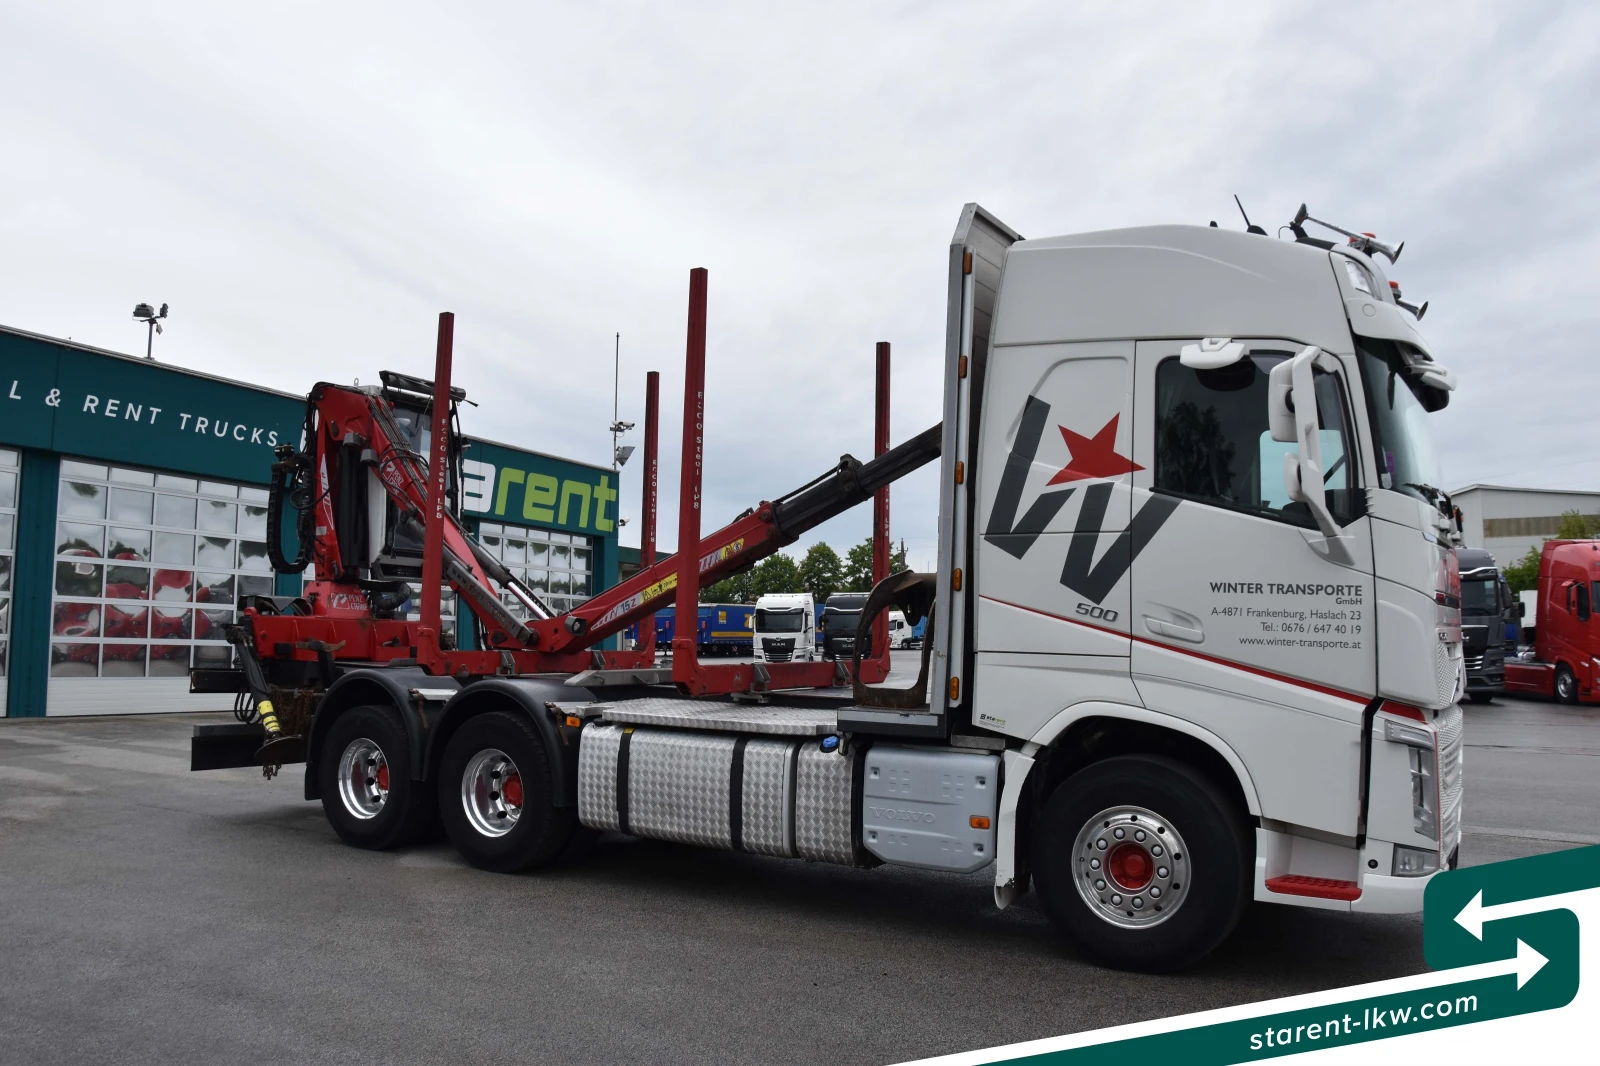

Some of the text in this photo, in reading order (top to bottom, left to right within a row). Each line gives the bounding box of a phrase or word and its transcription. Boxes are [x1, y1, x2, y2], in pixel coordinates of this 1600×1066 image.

[45, 388, 62, 407] &
[82, 394, 162, 425] RENT
[179, 412, 279, 447] TRUCKS
[1210, 582, 1363, 597] WINTER TRANSPORTE
[1335, 597, 1363, 606] GmbH
[1075, 602, 1119, 623] 500
[1210, 607, 1362, 621] A-4871 Frankenburg, Haslach 23
[1281, 623, 1305, 633] 0676
[1313, 624, 1332, 634] 647
[1334, 625, 1347, 634] 40
[1350, 625, 1362, 635] 19
[1239, 637, 1362, 650] www.winter-transporte.at
[868, 806, 936, 824] VOLVO
